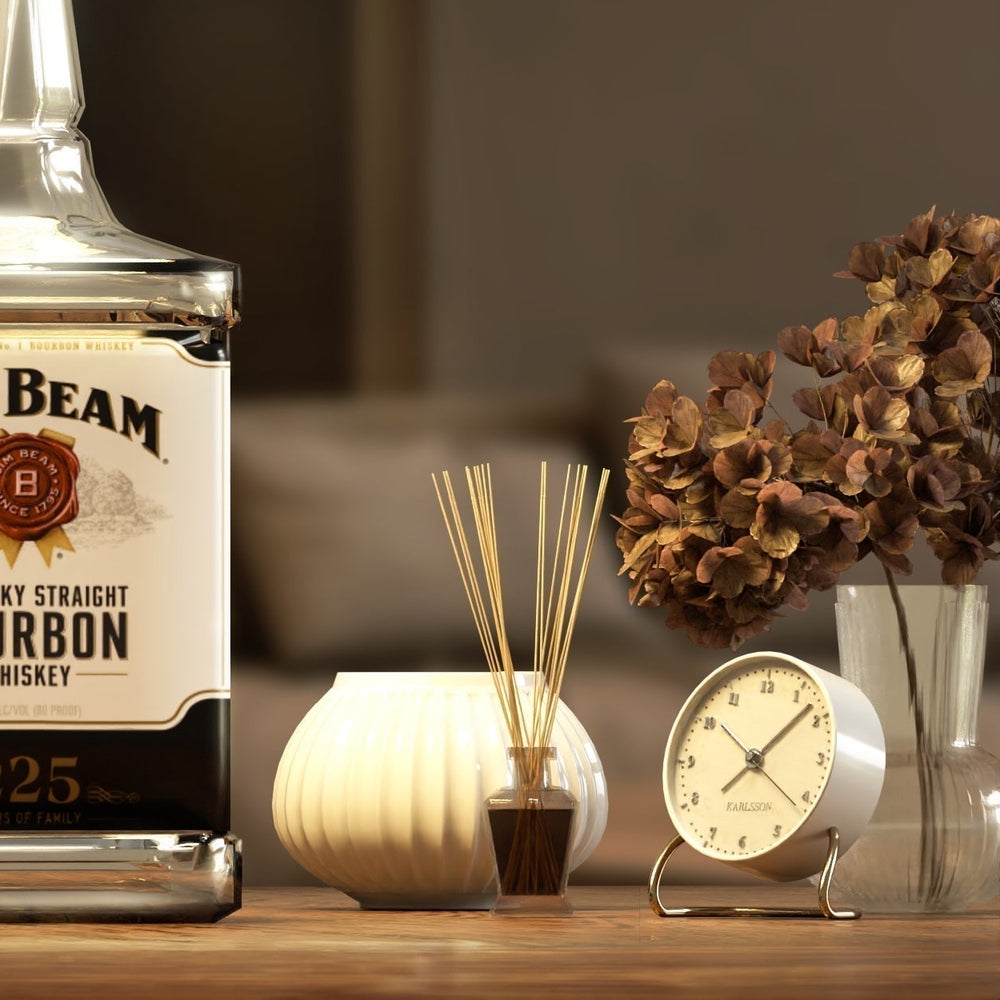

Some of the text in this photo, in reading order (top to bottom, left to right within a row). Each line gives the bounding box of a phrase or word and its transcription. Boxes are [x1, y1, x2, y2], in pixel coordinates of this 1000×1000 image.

[30, 341, 80, 351] BOURBON
[85, 341, 135, 351] WHISKEY
[3, 367, 163, 460] BEAM
[20, 448, 58, 476] BEAM
[15, 469, 37, 496] B
[34, 488, 60, 514] 1795
[34, 585, 129, 607] STRAIGHT
[812, 715, 820, 728] 2
[687, 755, 695, 769] 9
[816, 752, 825, 766] 3
[692, 792, 699, 805] 8
[801, 790, 812, 803] 4
[726, 802, 773, 812] KARLSSON
[16, 811, 32, 824] OF
[38, 811, 81, 825] FAMILY
[738, 835, 748, 848] 6
